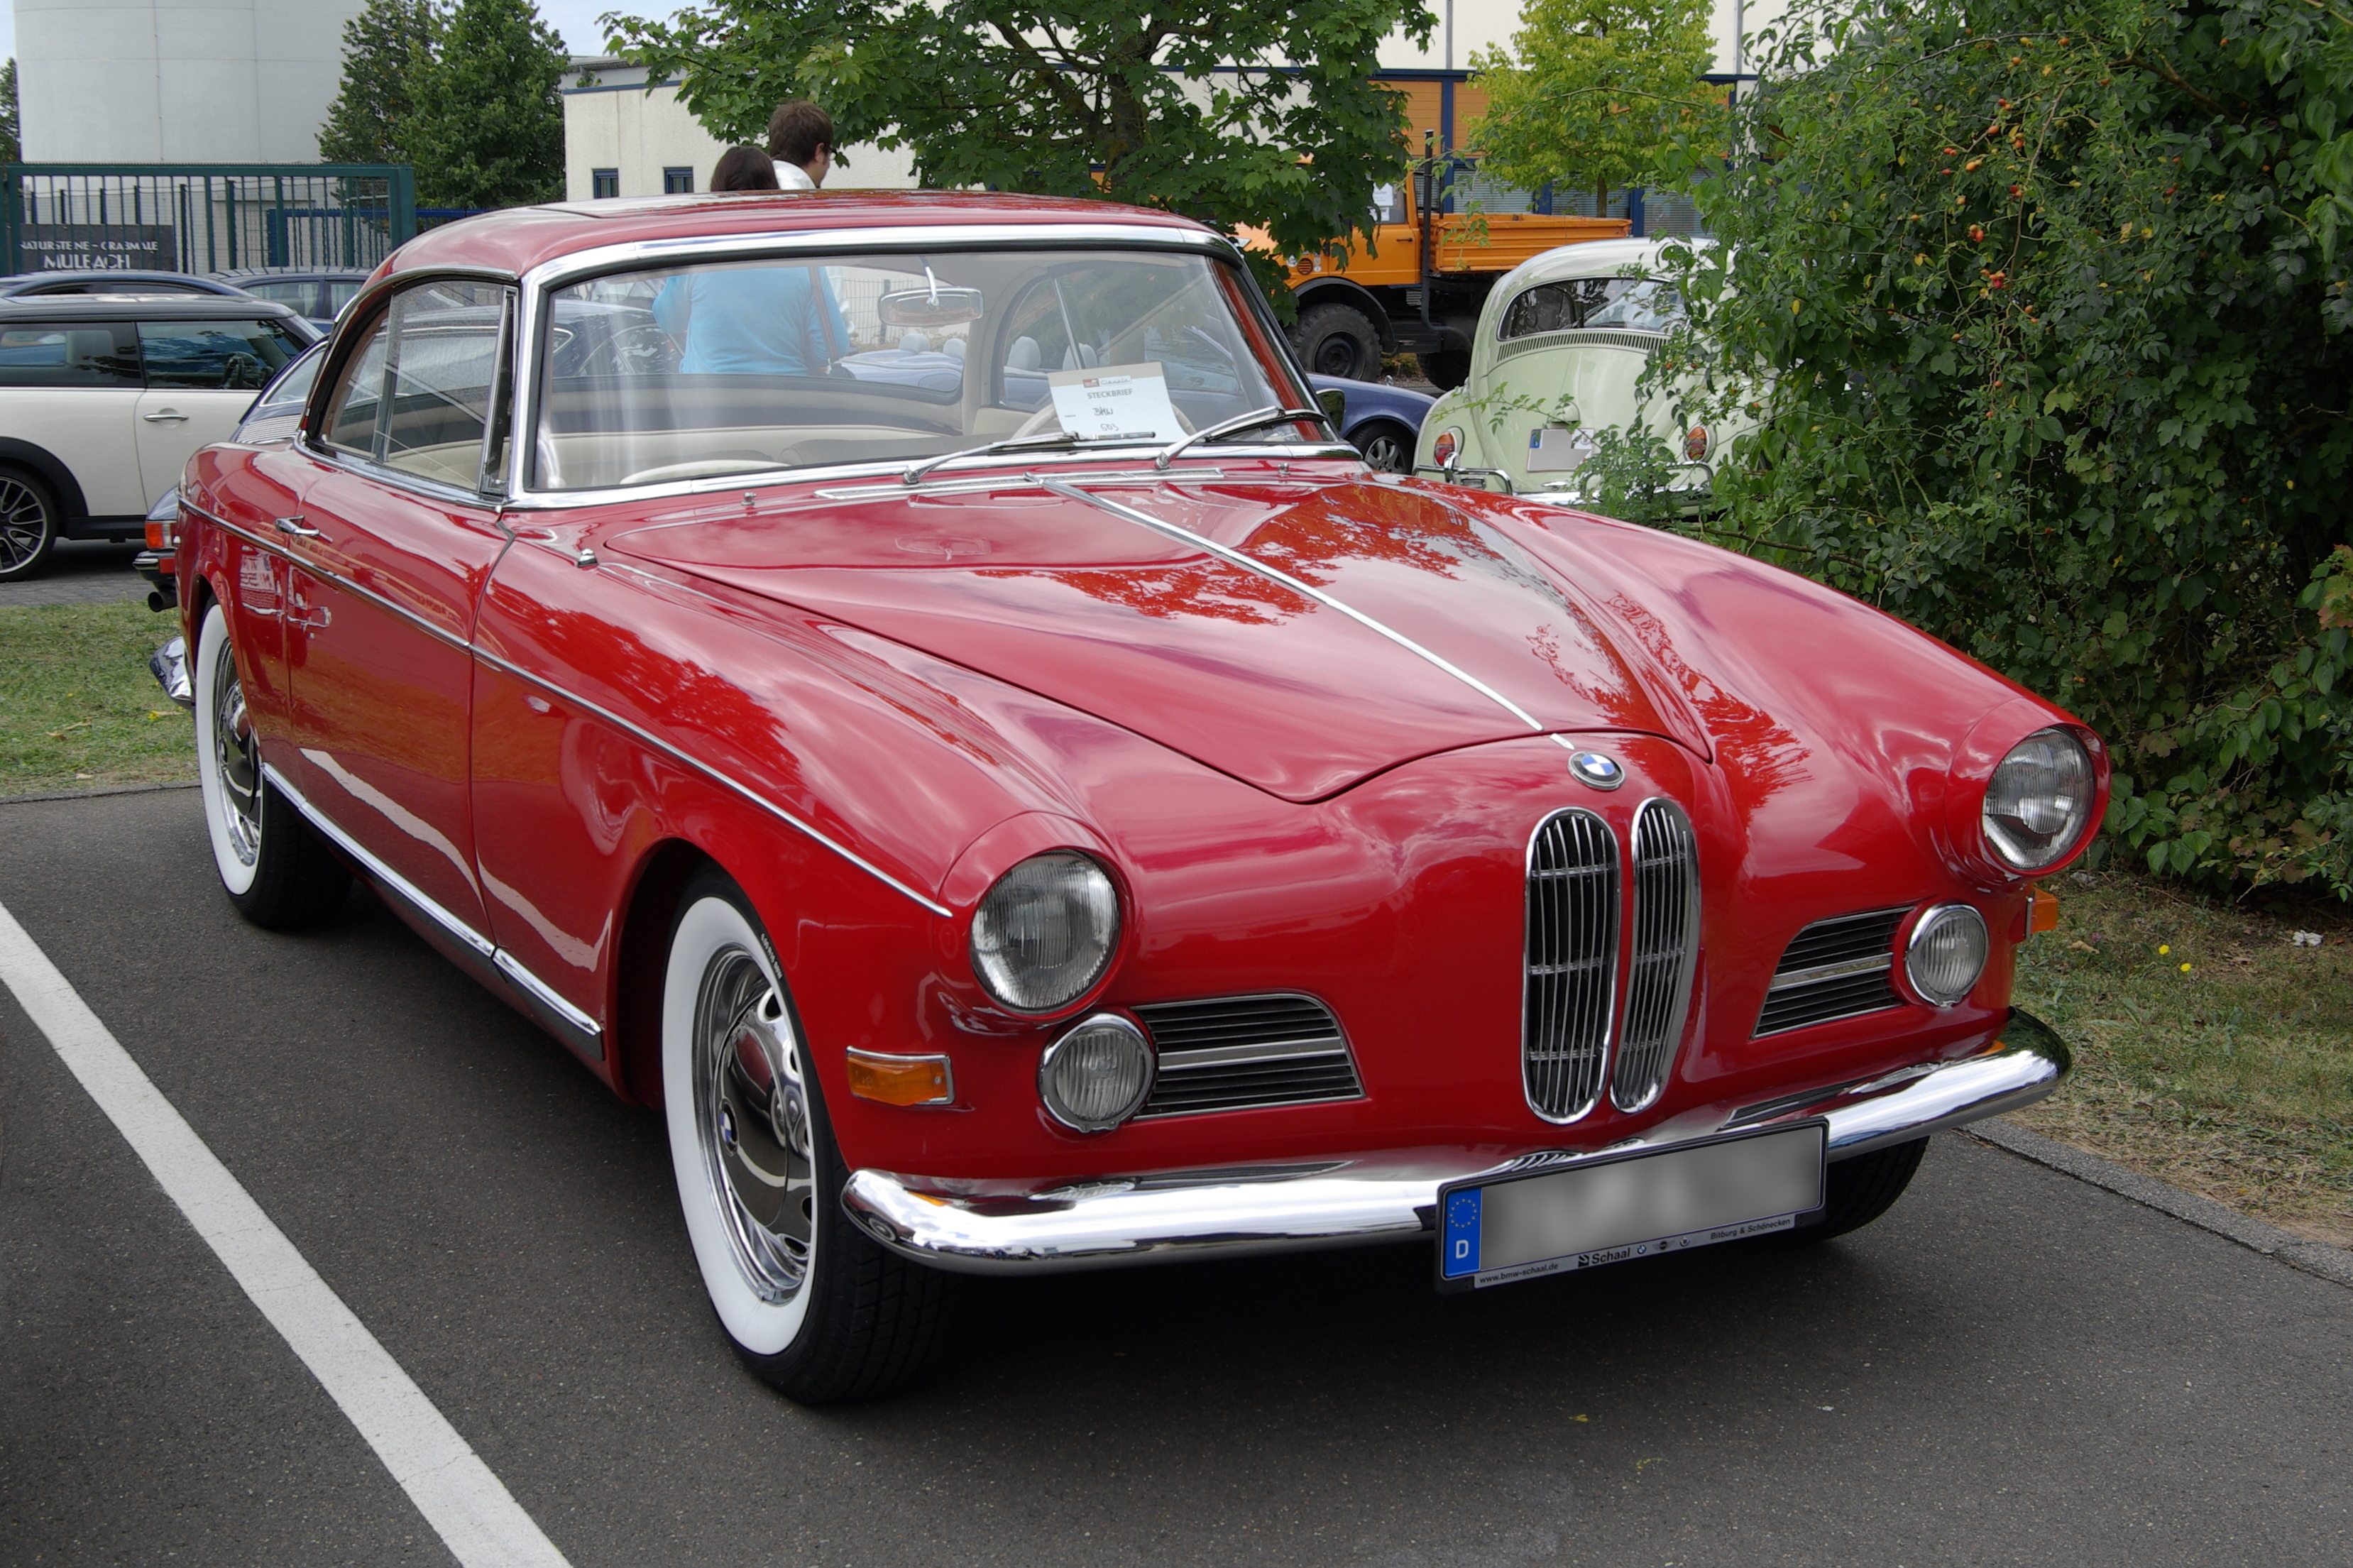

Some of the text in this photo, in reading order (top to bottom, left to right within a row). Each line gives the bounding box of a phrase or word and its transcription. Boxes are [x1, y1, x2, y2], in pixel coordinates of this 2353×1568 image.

[1087, 388, 1133, 400] STECKBRIEF
[1092, 406, 1114, 416] BMW
[1710, 1228, 1738, 1240] Bitburg
[1747, 1217, 1791, 1232] Schönecken
[1455, 1239, 1469, 1259] D
[1591, 1248, 1631, 1264] Schaal
[1479, 1263, 1559, 1283] www.bmw-schaal.de
